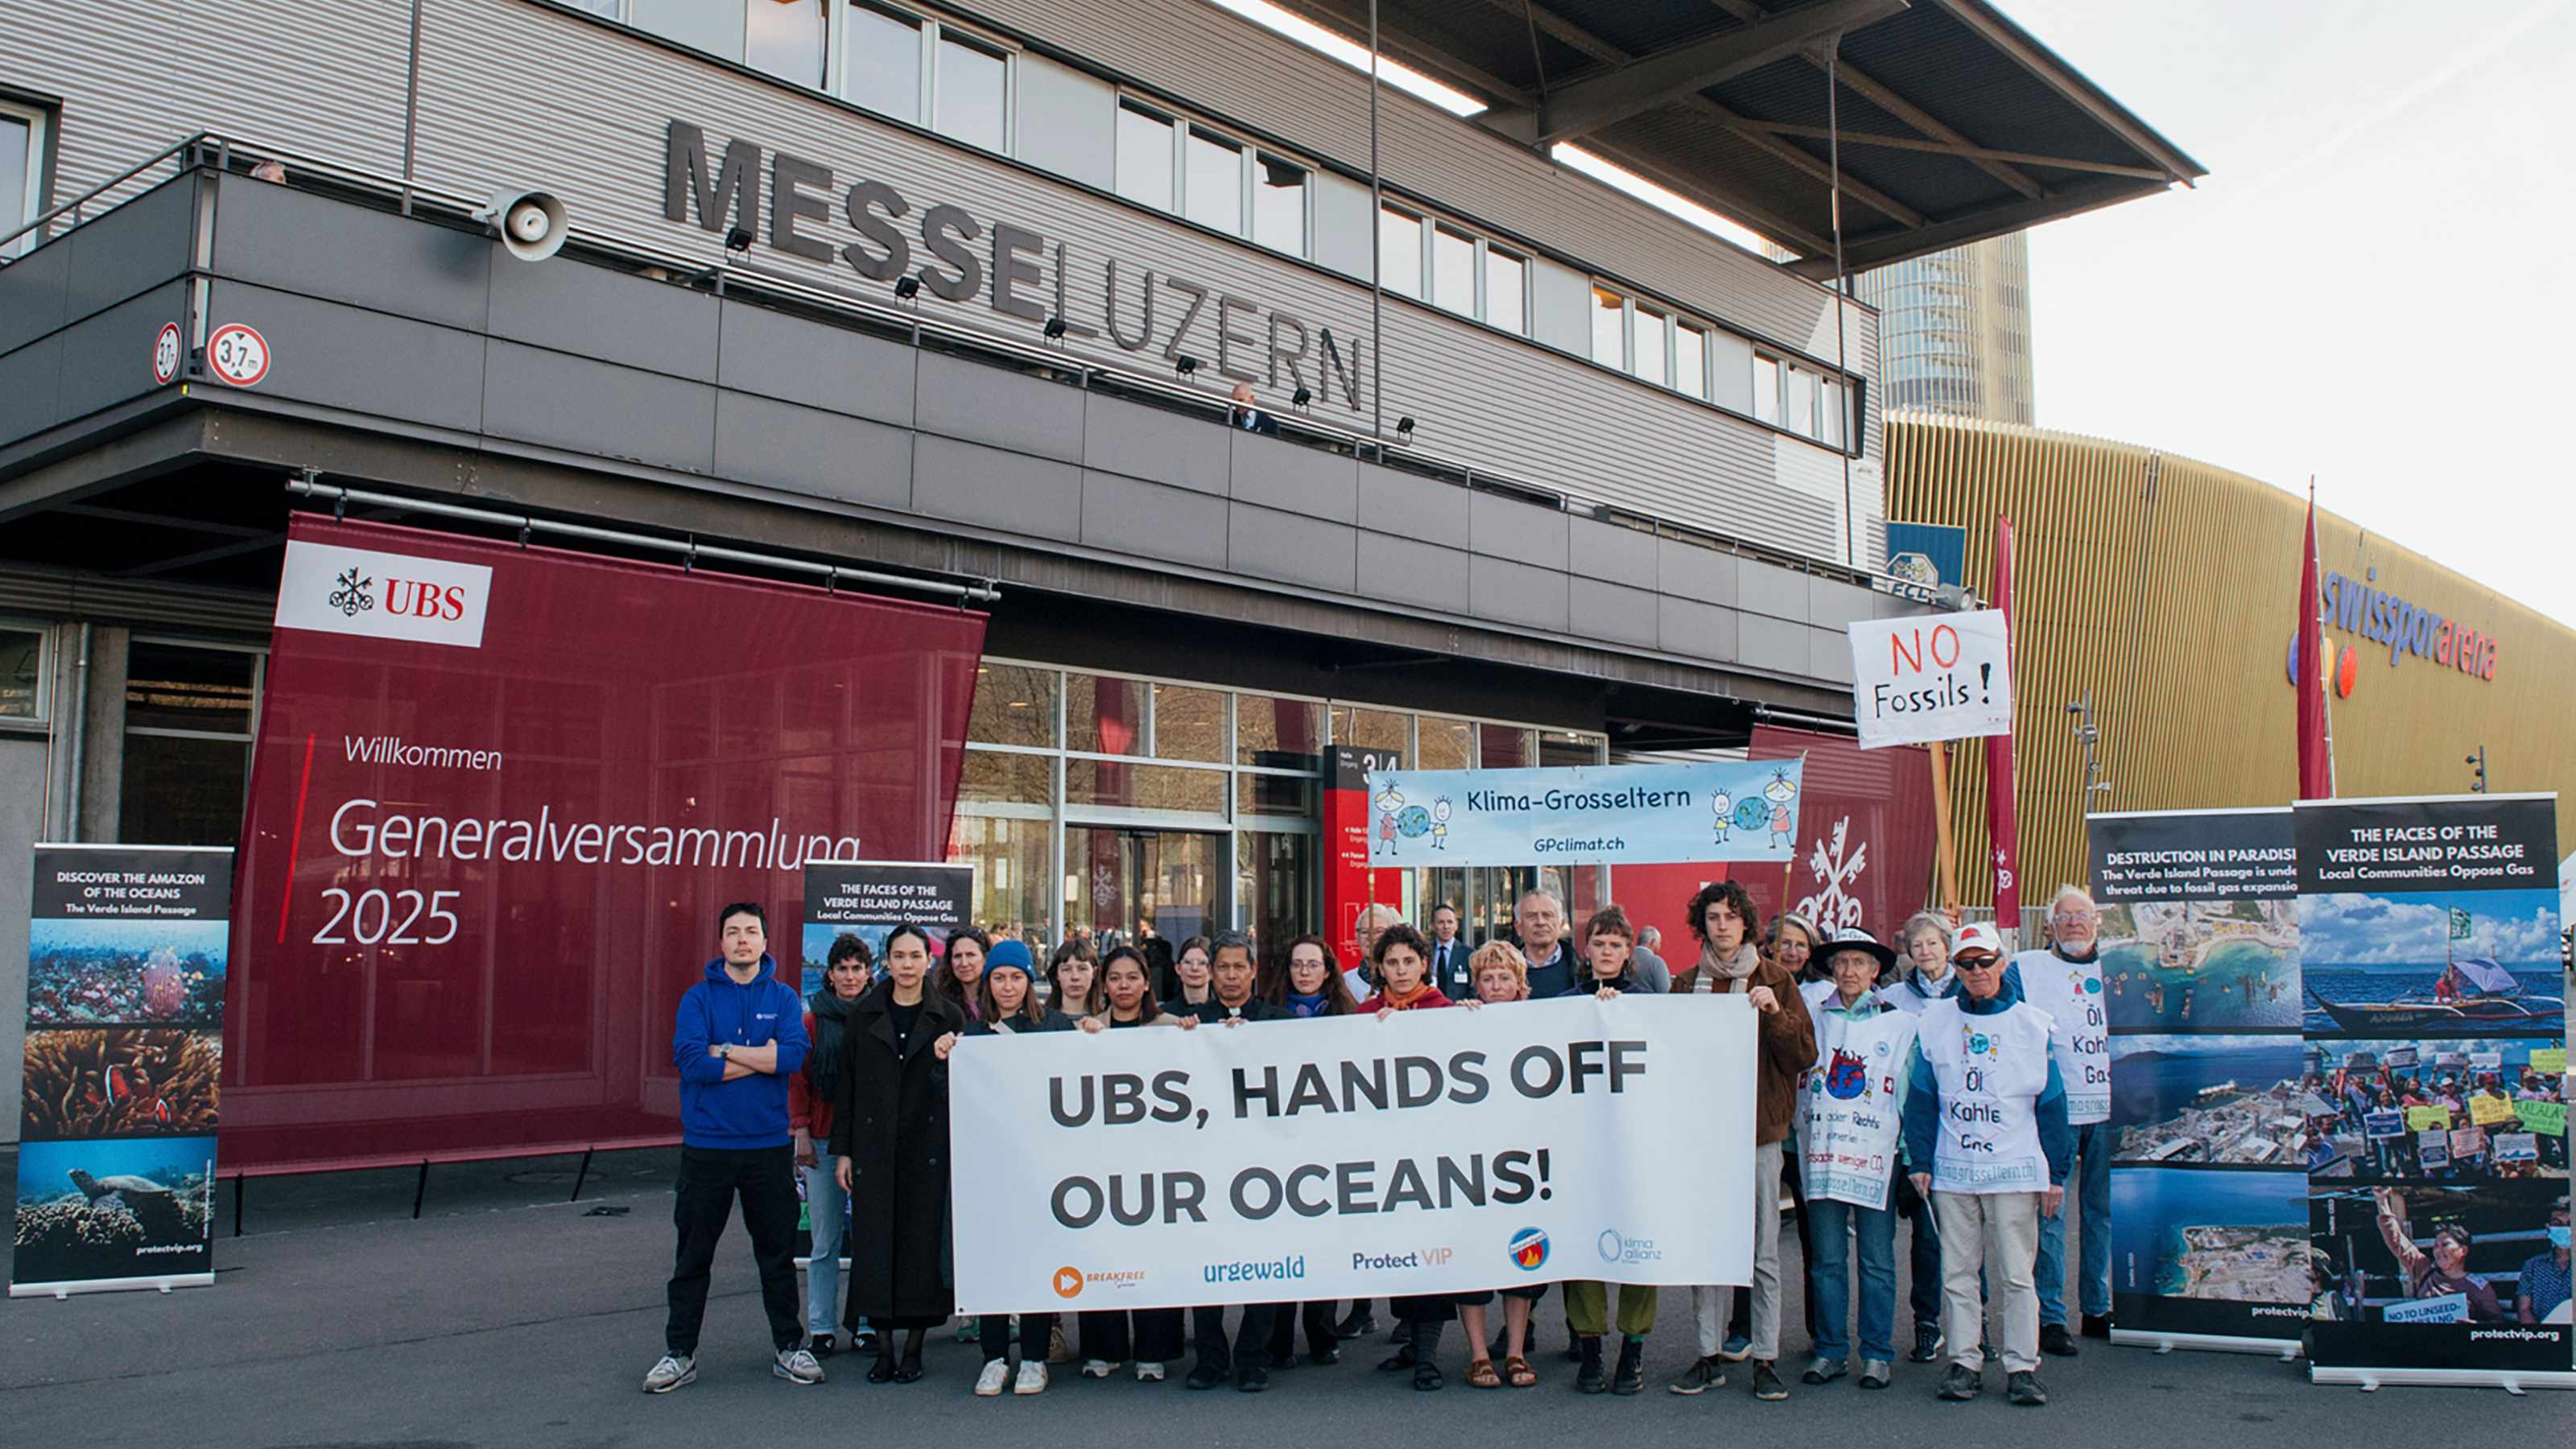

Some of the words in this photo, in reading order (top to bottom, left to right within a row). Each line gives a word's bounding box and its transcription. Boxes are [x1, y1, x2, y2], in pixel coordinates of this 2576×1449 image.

[221, 339, 248, 369] 3,7
[385, 576, 466, 621] UBS
[2324, 566, 2499, 681] swissporarena
[1892, 624, 1960, 676] NO
[345, 735, 502, 770] Willkommen
[1467, 786, 1690, 812] Klima-Grosseltern
[2351, 828, 2382, 843] THE
[2385, 827, 2437, 841] FACES
[2440, 826, 2463, 840] OF
[2467, 824, 2498, 839] THE
[1534, 837, 1624, 853] GPclimat.ch
[2326, 848, 2379, 863] VERDE
[2383, 847, 2442, 861] ISLAND
[2446, 844, 2524, 860] PASSAGE
[2107, 851, 2206, 865] DESTRUCTION
[2209, 850, 2224, 862] IN
[57, 873, 120, 884] DISCOVER
[123, 873, 146, 884] THE
[147, 873, 205, 885] AMAZON
[2102, 869, 2124, 881] The
[2125, 869, 2161, 880] Verde
[2165, 867, 2200, 878] Island
[2202, 866, 2252, 879] Passage
[2256, 865, 2265, 876] is
[2268, 865, 2297, 877] unde
[2318, 867, 2355, 880] Local
[2357, 865, 2447, 879] Communities
[2450, 864, 2504, 879] Oppose
[2506, 863, 2535, 876] Gas
[84, 888, 101, 898] OF
[104, 888, 126, 898] THE
[129, 888, 181, 899] OCEANS
[840, 884, 861, 894] THE
[863, 885, 898, 895] FACES
[900, 886, 914, 895] OF
[917, 886, 937, 896] THE
[2106, 885, 2143, 896] threat
[2145, 883, 2167, 894] due
[2169, 884, 2182, 894] to
[2184, 882, 2215, 894] fossil
[2218, 883, 2240, 895] gas
[2243, 881, 2298, 894] expansio
[65, 903, 85, 914] The
[87, 904, 118, 914] Verde
[121, 904, 151, 914] Island
[154, 905, 197, 916] Passage
[824, 898, 859, 908] VERDE
[861, 898, 901, 909] ISLAND
[902, 899, 953, 910] PASSAGE
[312, 889, 460, 946] 2025
[817, 910, 841, 920] Local
[843, 911, 902, 922] Communities
[904, 914, 939, 923] Oppose
[940, 914, 958, 923] Gas
[2087, 1004, 2103, 1026] Öl
[2072, 1035, 2107, 1055] Koh
[1049, 1070, 1209, 1129] UBS,
[1232, 1051, 1488, 1118] HANDS
[1510, 1041, 1647, 1099] OFF
[1967, 1067, 1983, 1092] Öl
[1950, 1101, 2001, 1123] Kohle
[1051, 1171, 1207, 1229] OUR
[1230, 1149, 1552, 1220] OCEANS!
[136, 1244, 203, 1256] protectvip.org
[1204, 1256, 1304, 1282] urgewald
[1353, 1253, 1417, 1269] Protect
[1421, 1249, 1452, 1265] VIP
[2252, 1306, 2314, 1319] protectvip.
[2388, 1311, 2403, 1321] NO
[2404, 1309, 2417, 1319] TO
[2471, 1328, 2560, 1342] protectvip.org
